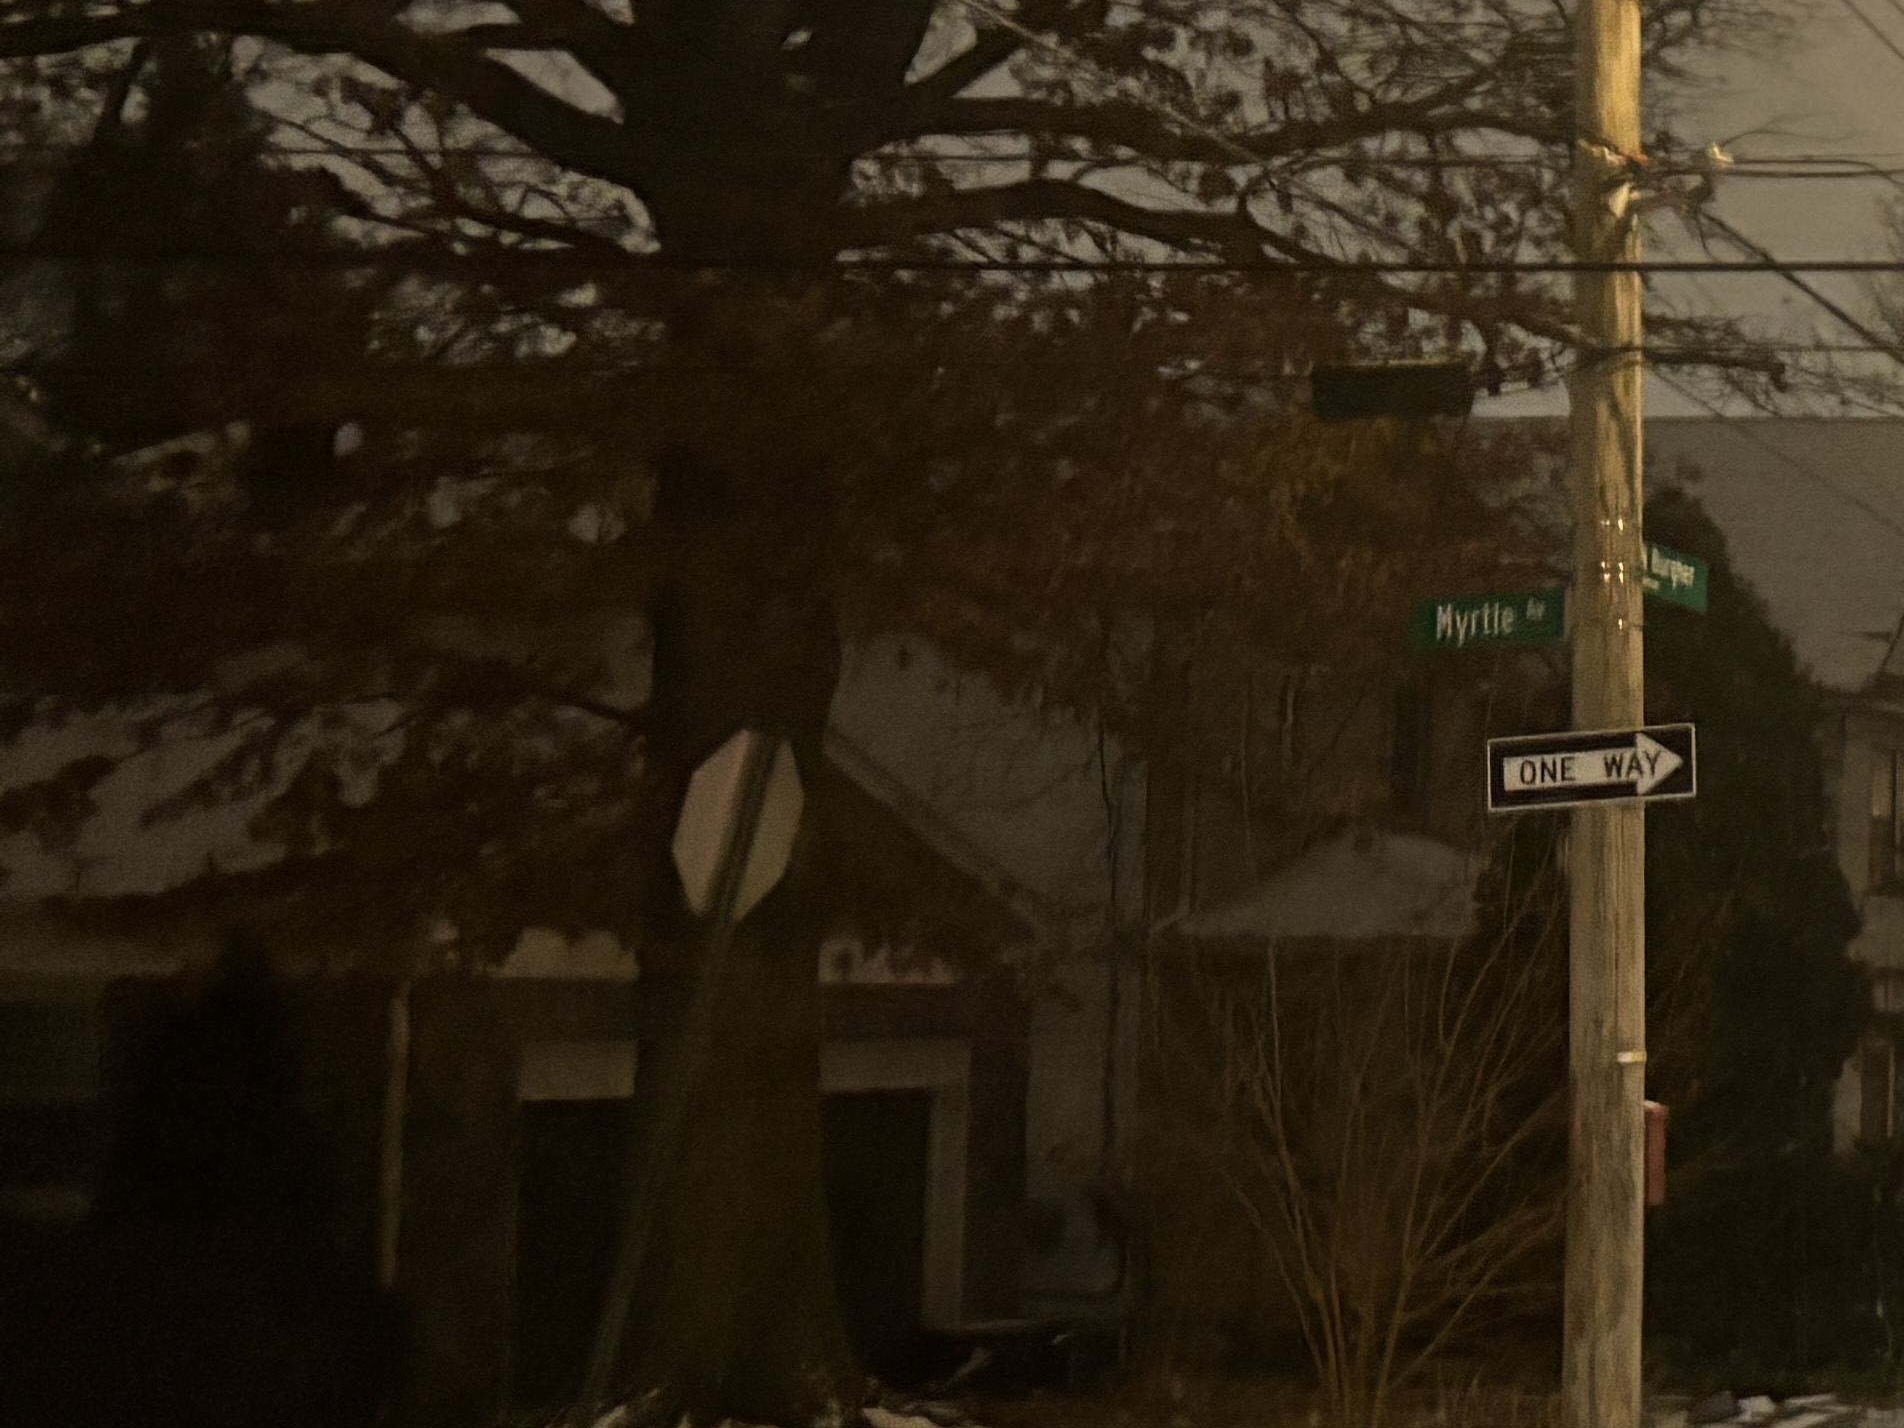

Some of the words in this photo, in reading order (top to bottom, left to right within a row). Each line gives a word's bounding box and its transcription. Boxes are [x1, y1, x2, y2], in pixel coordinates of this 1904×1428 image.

[1436, 601, 1515, 648] Myrtle
[1519, 755, 1576, 786] ONE
[1603, 749, 1662, 779] WAY
